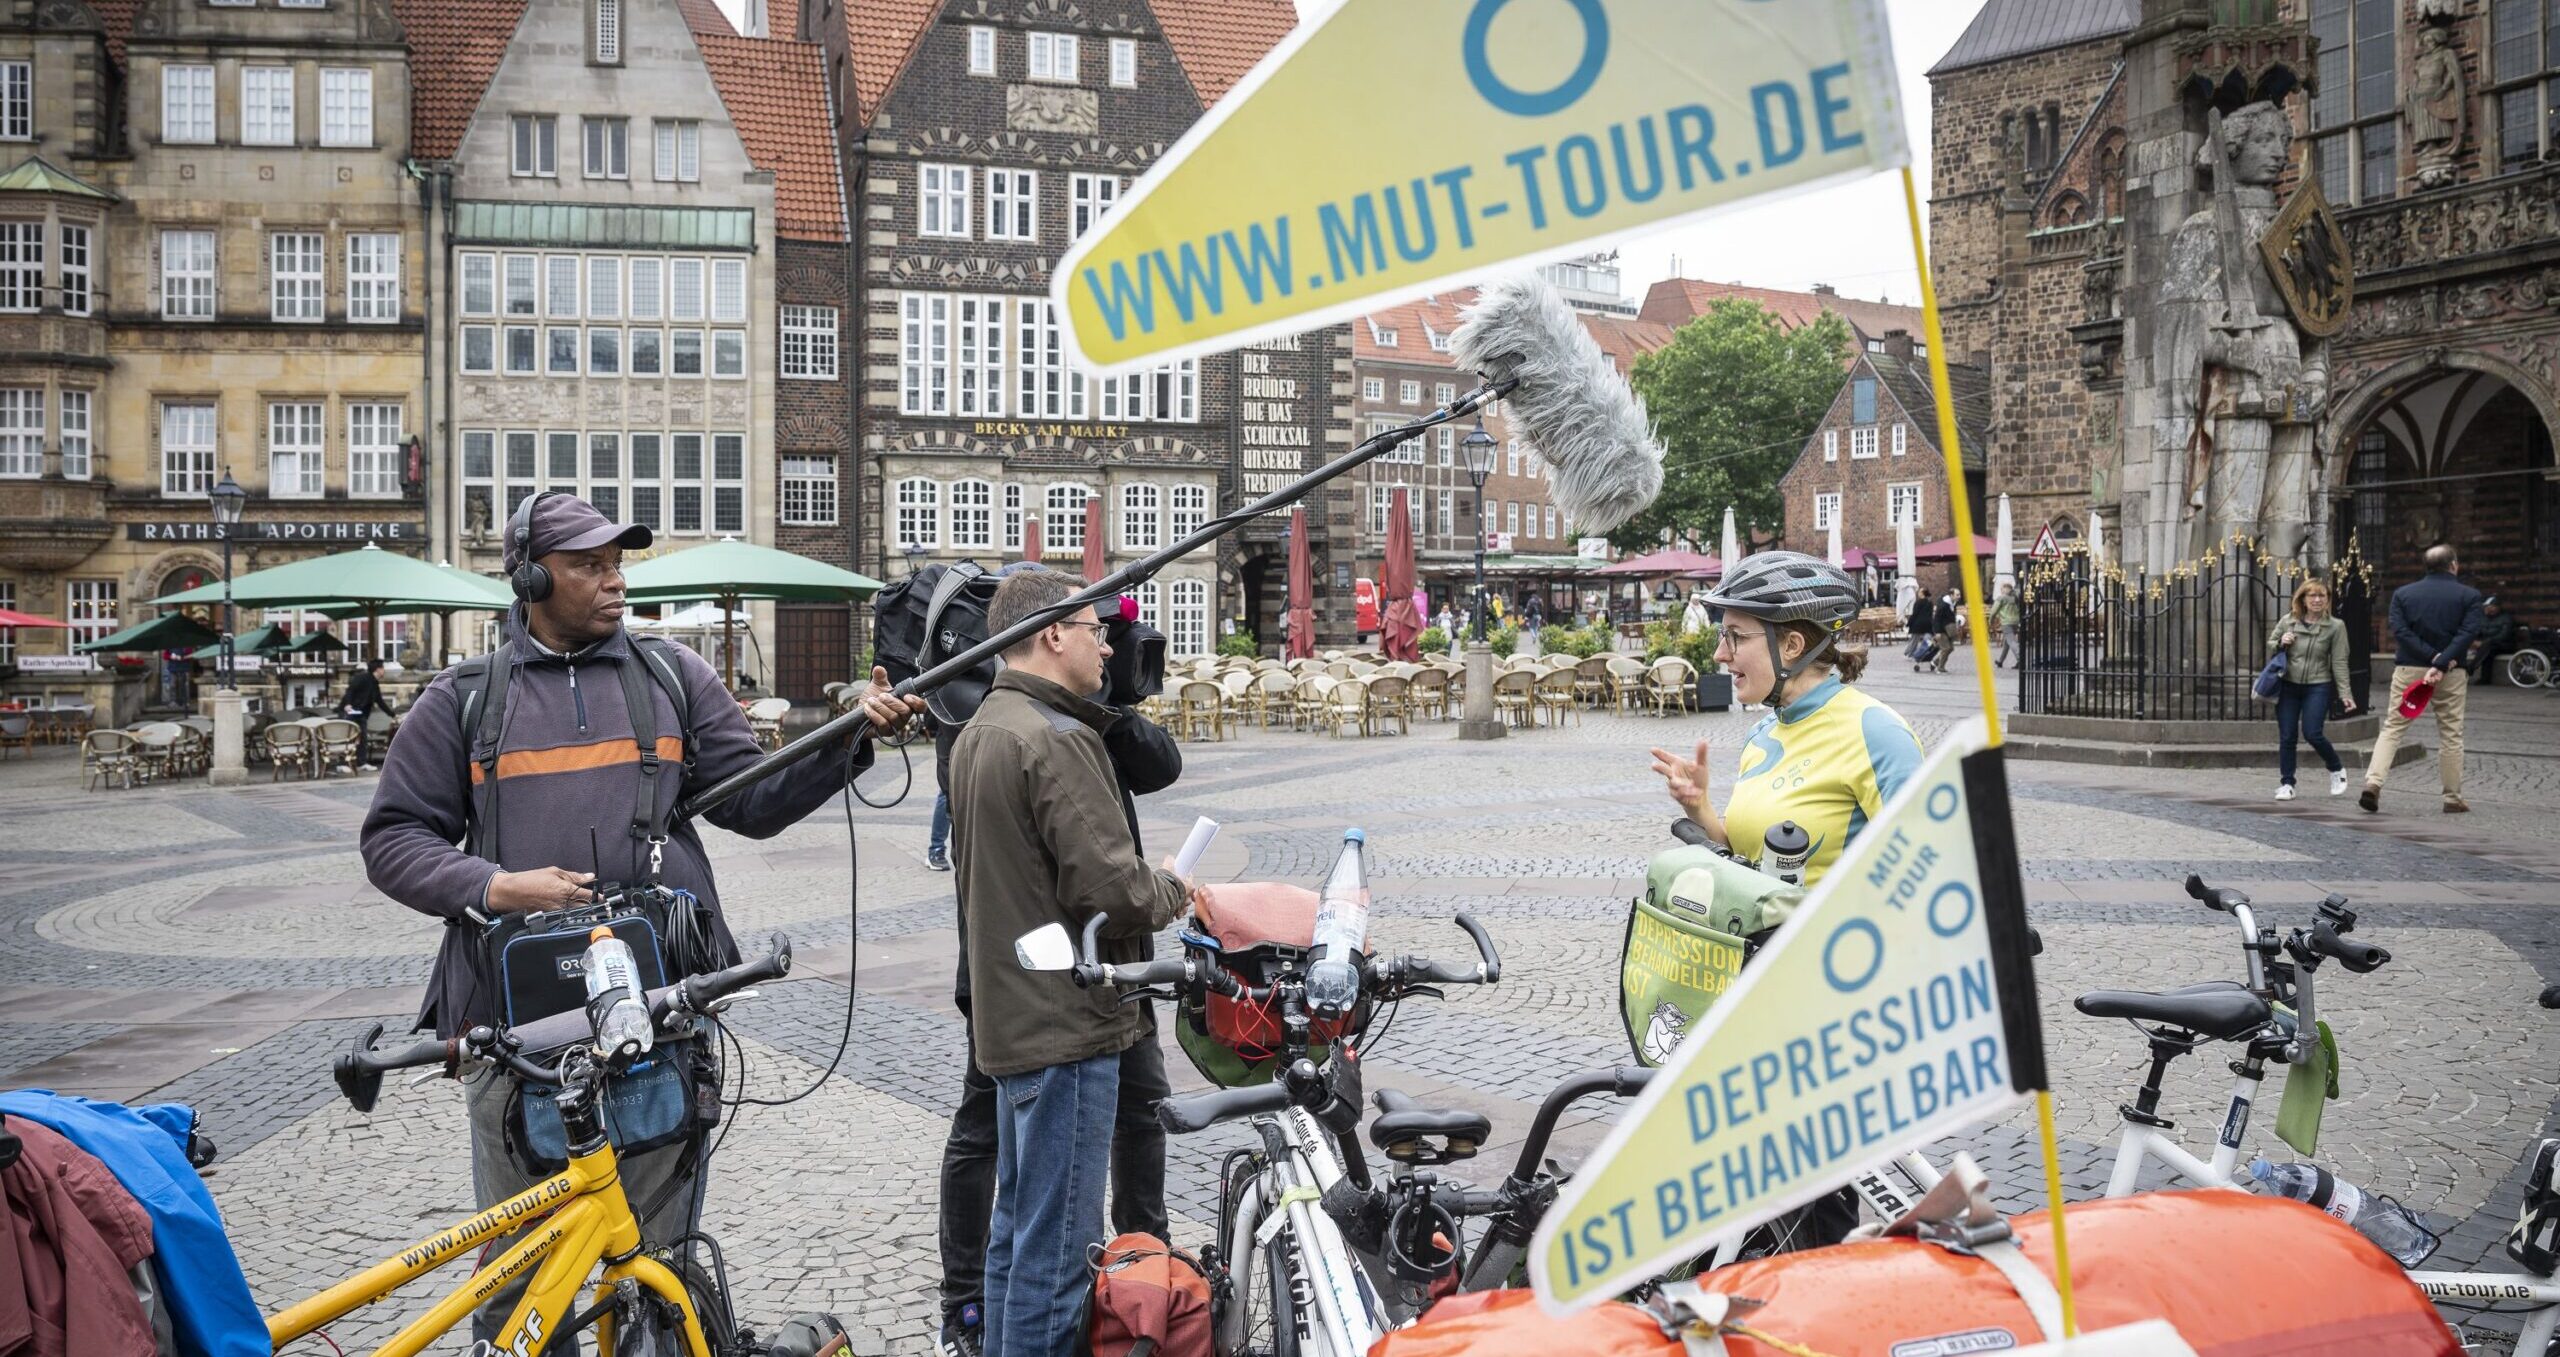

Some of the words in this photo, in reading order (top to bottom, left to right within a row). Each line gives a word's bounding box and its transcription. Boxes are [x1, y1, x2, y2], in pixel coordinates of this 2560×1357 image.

[1083, 61, 1865, 342] WWW.MUT-TOUR.DE
[1243, 354, 1269, 373] DER
[1243, 375, 1301, 399] BRÜDER,
[1036, 424, 1062, 436] AM
[1070, 425, 1129, 437] MARKT
[1243, 402, 1264, 421] DIE
[1268, 403, 1292, 422] DAS
[1243, 426, 1310, 446] SCHICKSAL
[1243, 449, 1302, 469] UNSERER
[145, 523, 226, 539] RATHS
[266, 523, 400, 539] APOTHEKE
[1867, 826, 1911, 888] MUT
[1886, 843, 1940, 911] TOUR
[1638, 910, 1741, 976] DEPRESSION
[1626, 964, 1652, 999] IST
[1685, 959, 1992, 1144] DEPRESSION
[1562, 1198, 1637, 1287] IST
[1654, 1034, 2004, 1241] BEHANDELBAR
[401, 1177, 571, 1269] www.mut-tour.de
[475, 1228, 563, 1299] mut-foerdern.de
